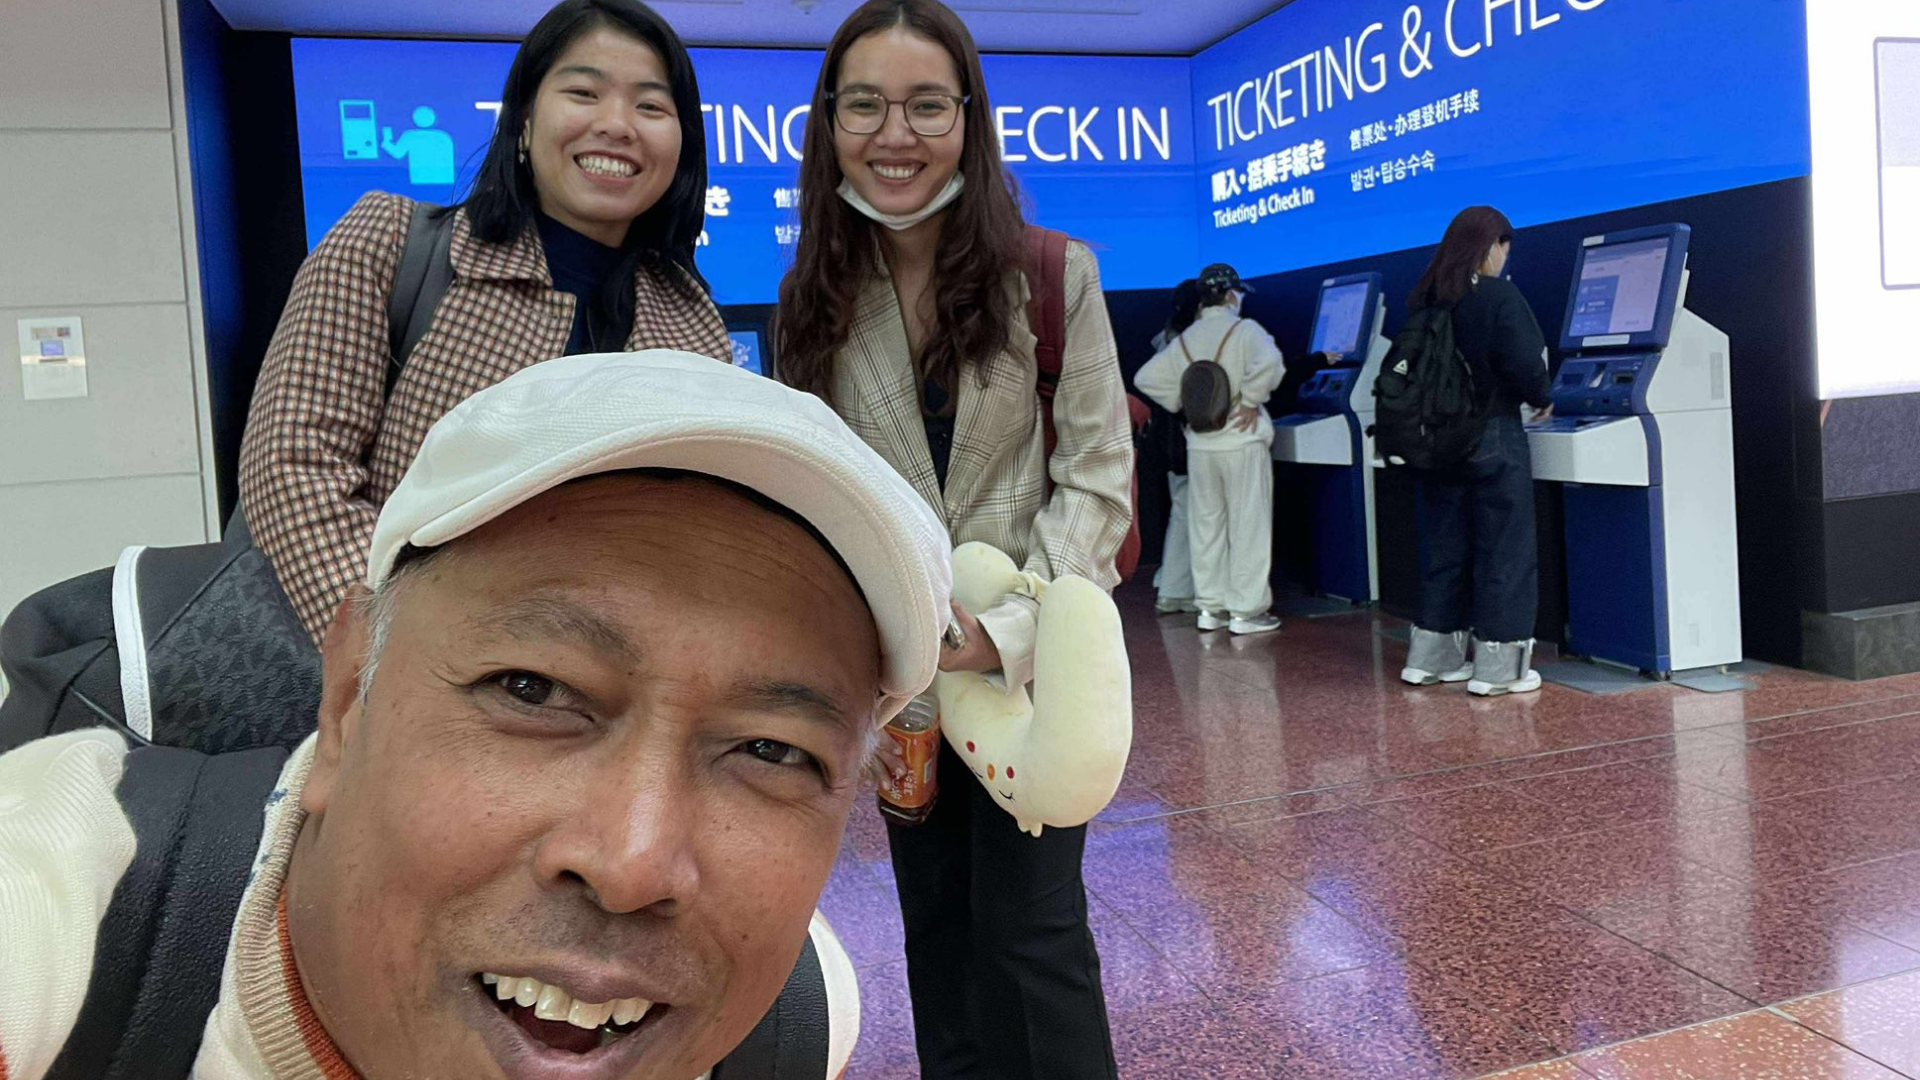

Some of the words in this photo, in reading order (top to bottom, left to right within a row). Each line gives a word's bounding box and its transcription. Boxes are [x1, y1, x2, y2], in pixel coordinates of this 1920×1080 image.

[1207, 22, 1388, 151] TICKETING
[1399, 4, 1433, 79] &
[995, 105, 1104, 162] ECK
[1117, 106, 1170, 161] IN
[1213, 203, 1258, 229] Ticketing
[1258, 198, 1268, 217] &
[1267, 187, 1301, 214] Check
[1301, 186, 1315, 205] In
